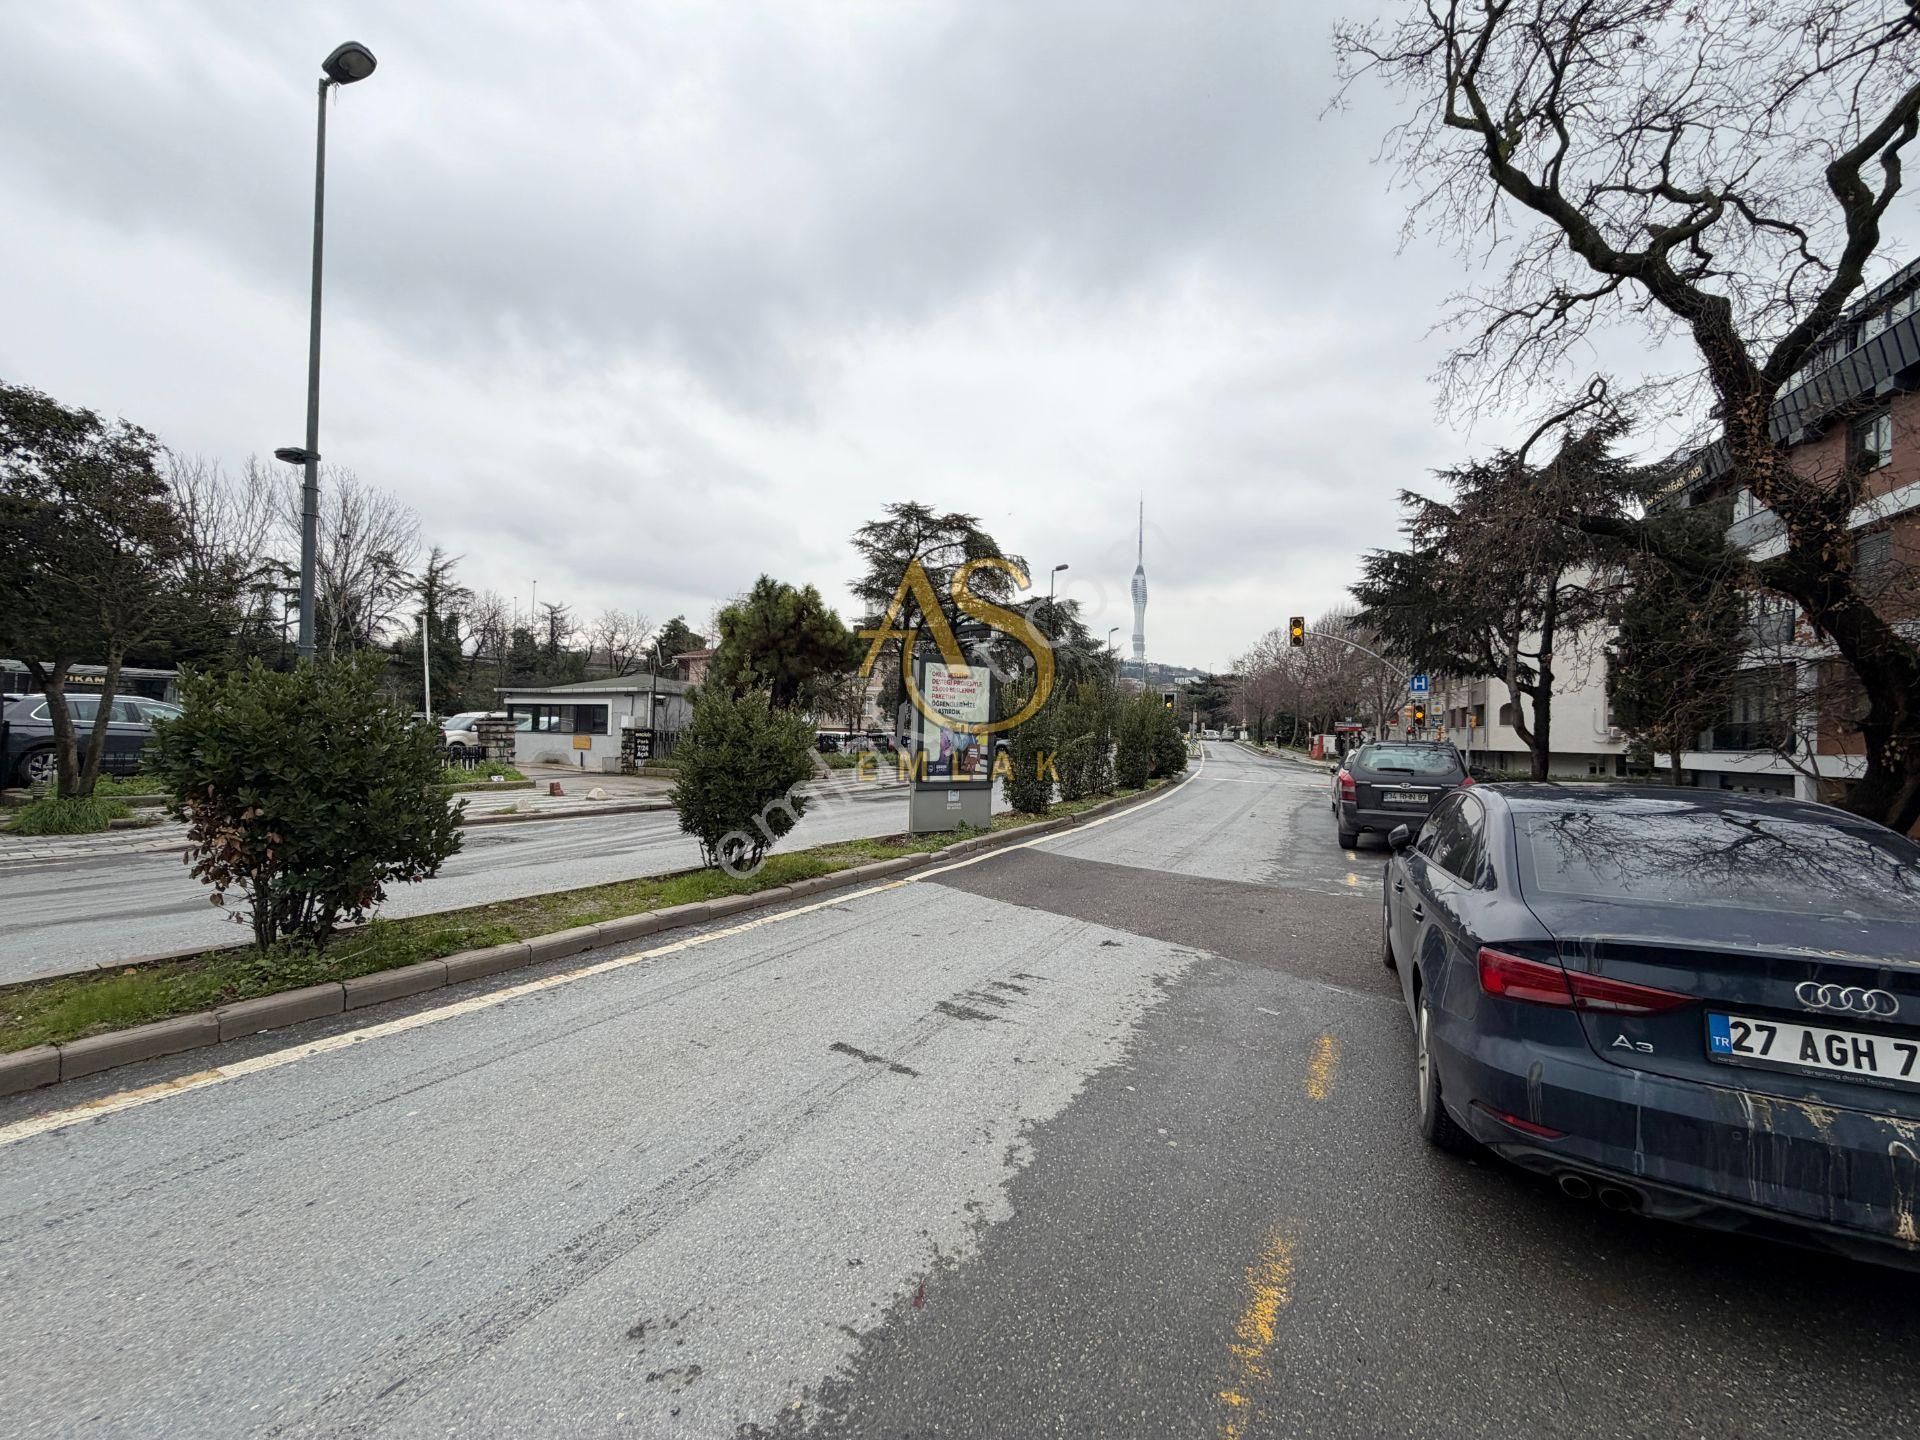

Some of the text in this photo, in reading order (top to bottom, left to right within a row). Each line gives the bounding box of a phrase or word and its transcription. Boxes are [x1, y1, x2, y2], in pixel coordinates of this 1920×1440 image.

[64, 675, 106, 683] IKAM
[1413, 677, 1426, 690] H
[1611, 1034, 1654, 1053] A3
[1713, 1036, 1730, 1048] TR
[1730, 1021, 1778, 1057] 27
[1799, 1030, 1878, 1072] AGH
